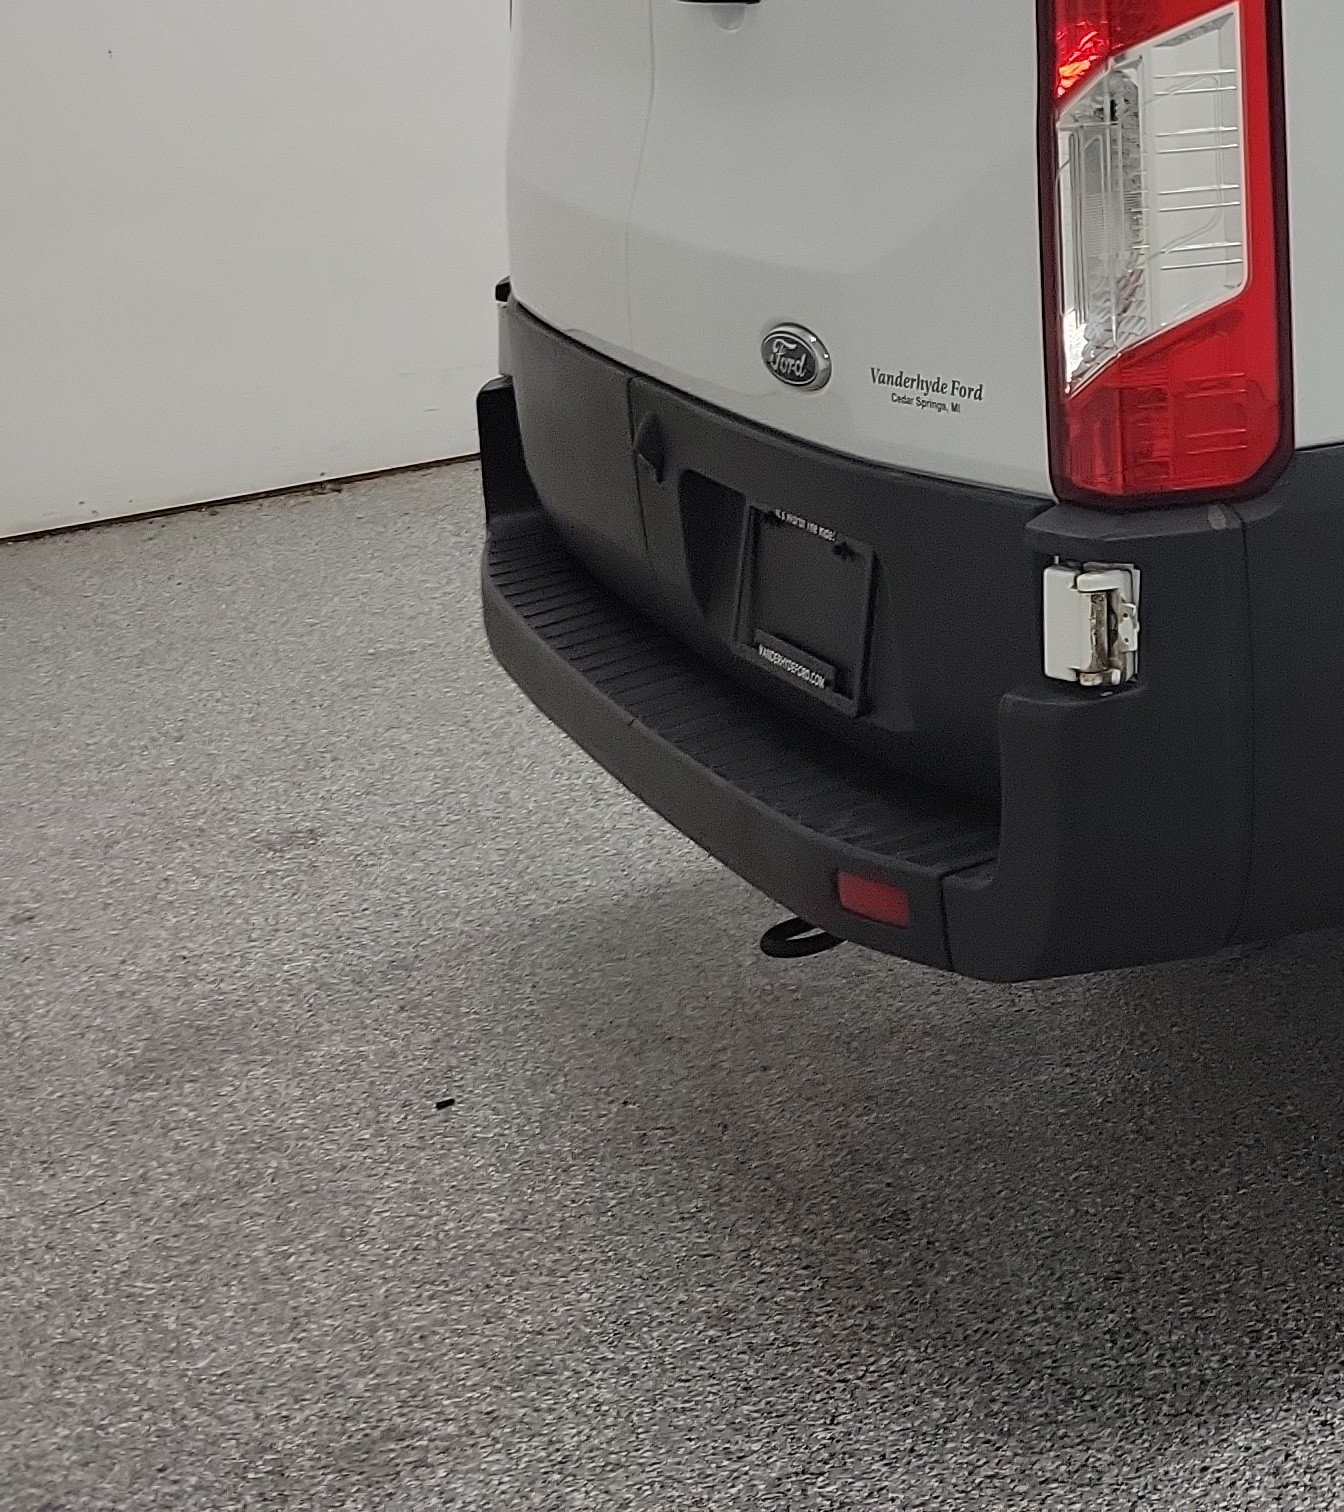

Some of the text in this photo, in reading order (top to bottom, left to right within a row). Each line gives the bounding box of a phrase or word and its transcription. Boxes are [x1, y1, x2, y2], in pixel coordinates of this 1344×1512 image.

[770, 338, 807, 377] Ford
[870, 367, 983, 401] Vanderhyde Ford
[891, 392, 961, 413] Cedar Springs, MI
